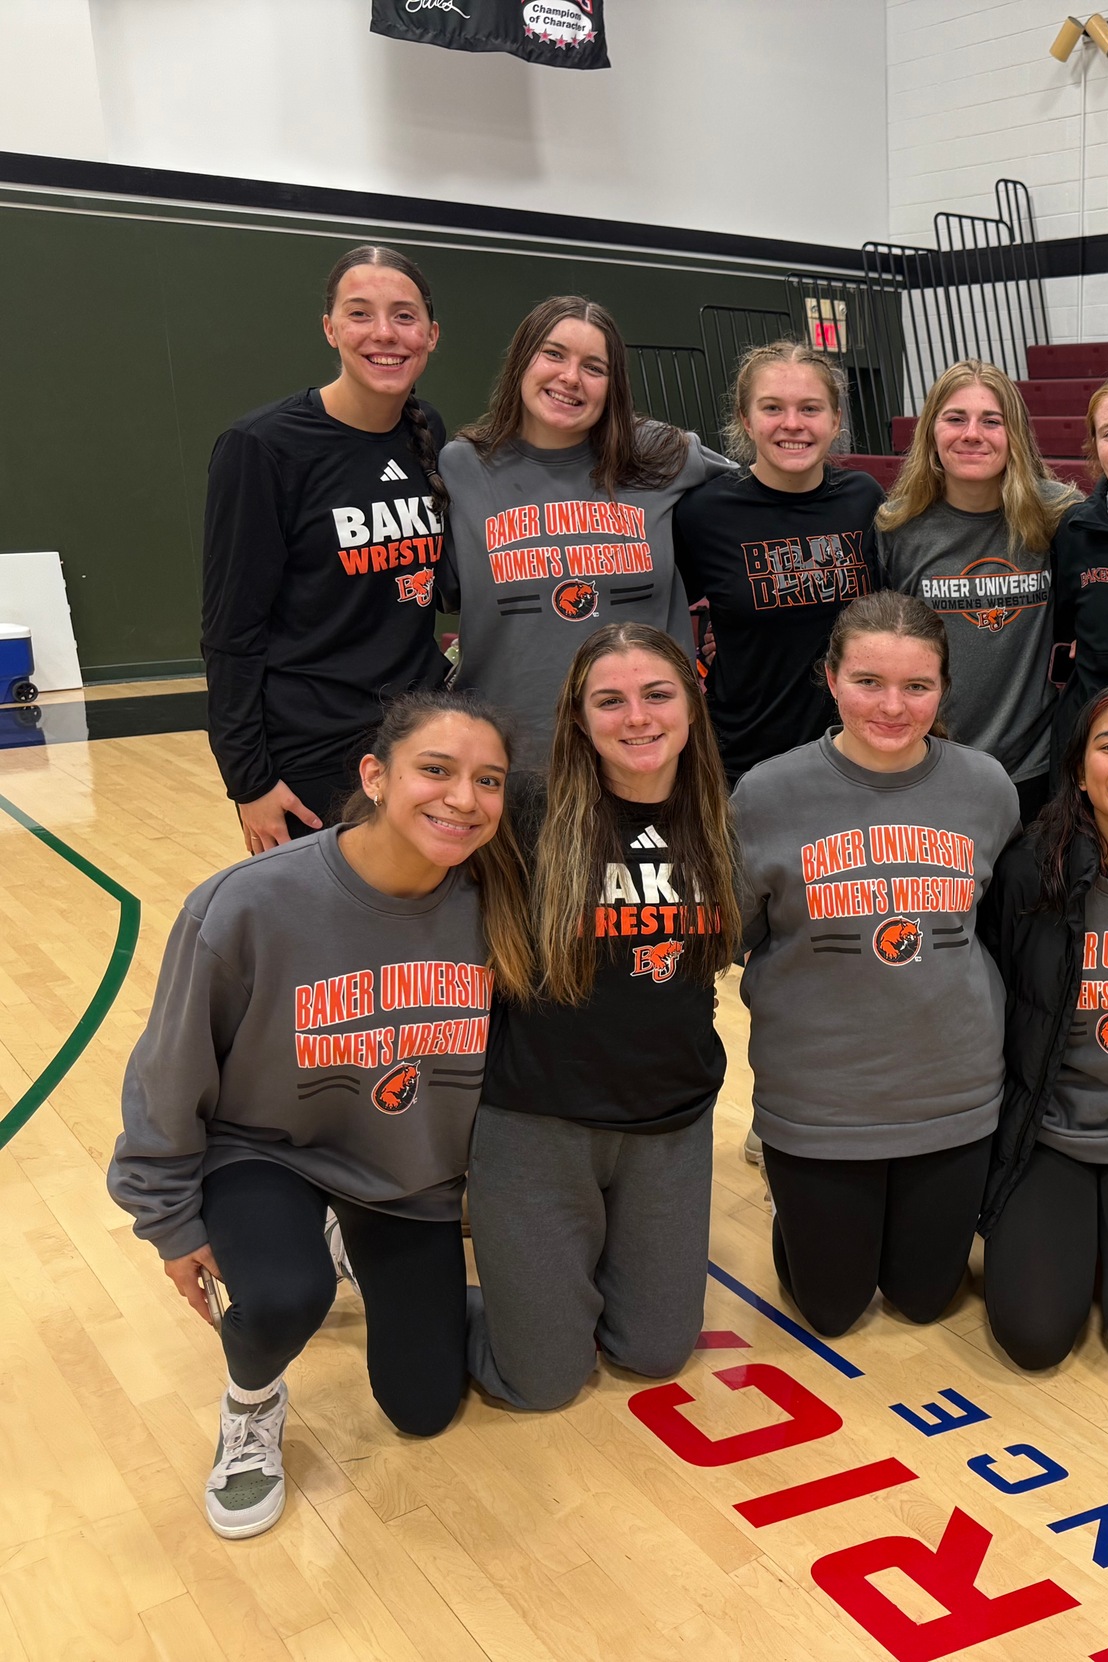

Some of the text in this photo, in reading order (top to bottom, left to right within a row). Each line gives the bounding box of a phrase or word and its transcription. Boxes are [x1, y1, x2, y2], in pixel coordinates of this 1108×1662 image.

[529, 15, 586, 32] of Character
[485, 500, 646, 552] BAKER UNIVERSITY
[488, 542, 653, 584] WOMEN'S WRESTLING
[741, 531, 864, 576] BOLDLY
[922, 578, 970, 598] BAKER
[932, 591, 1048, 610] WOMEN'S WRESTLING
[801, 824, 975, 884] BAKER UNIVERSITY
[806, 876, 976, 920] WOMEN'S WRESTLING
[295, 961, 495, 1031] BAKER UNIVERSITY
[295, 1026, 395, 1069] WOMEN'S
